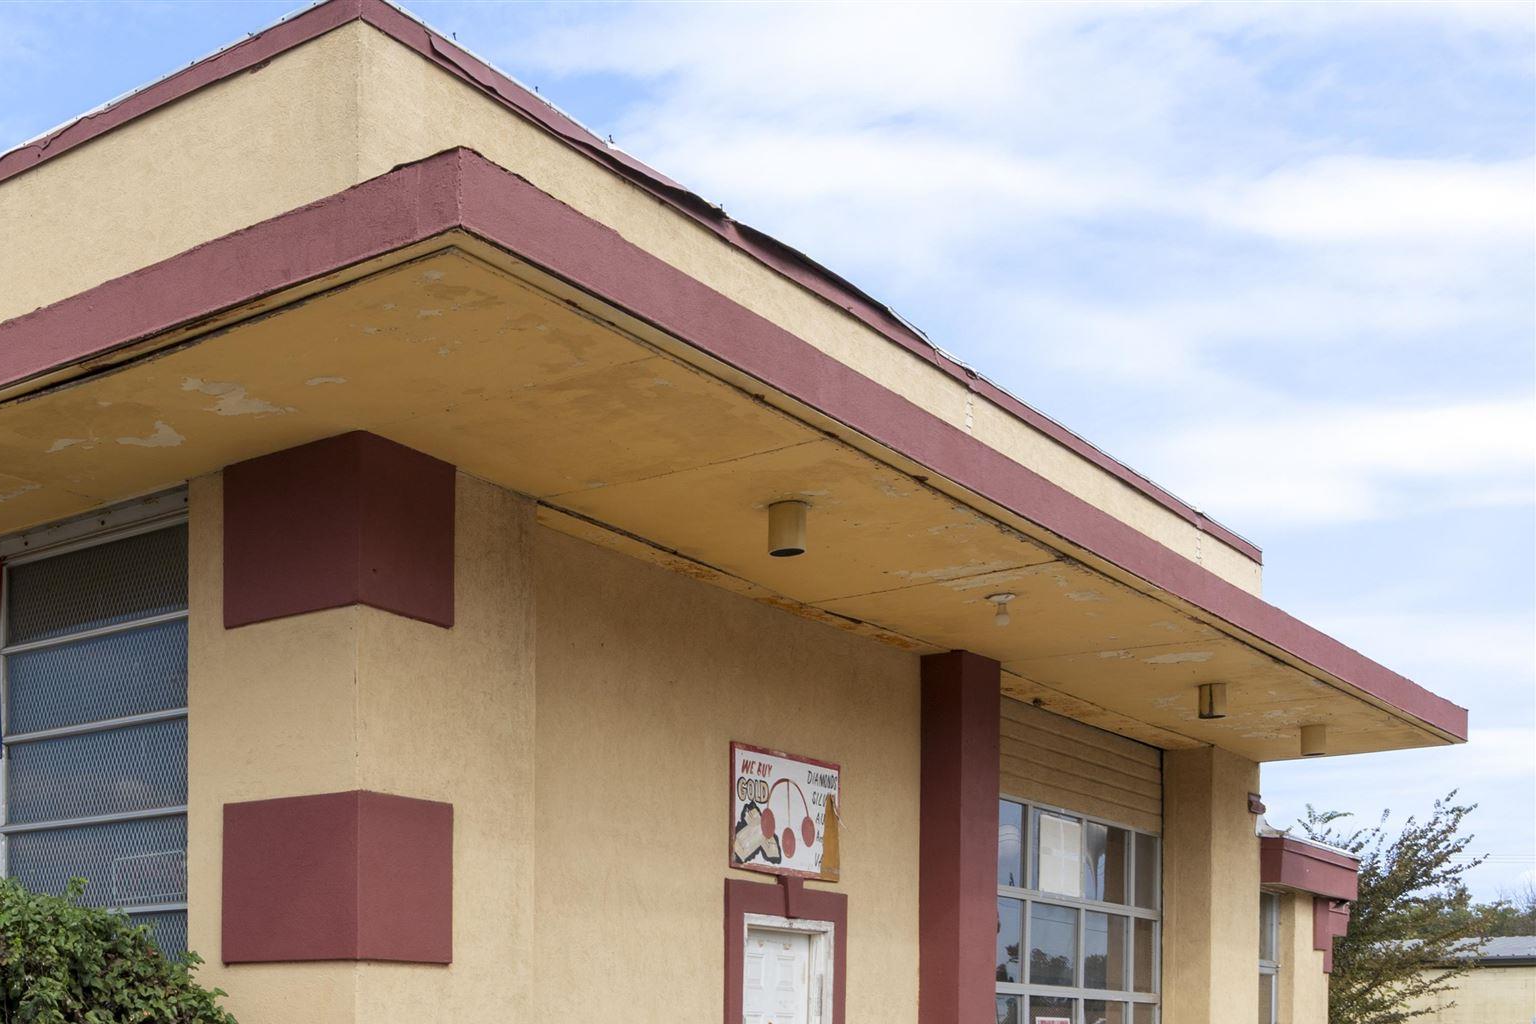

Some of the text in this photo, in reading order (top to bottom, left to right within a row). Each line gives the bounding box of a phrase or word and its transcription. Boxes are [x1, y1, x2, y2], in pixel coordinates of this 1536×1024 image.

[741, 759, 773, 777] WE BUY
[737, 777, 770, 804] GOLD
[807, 770, 838, 791] DIAMONDS
